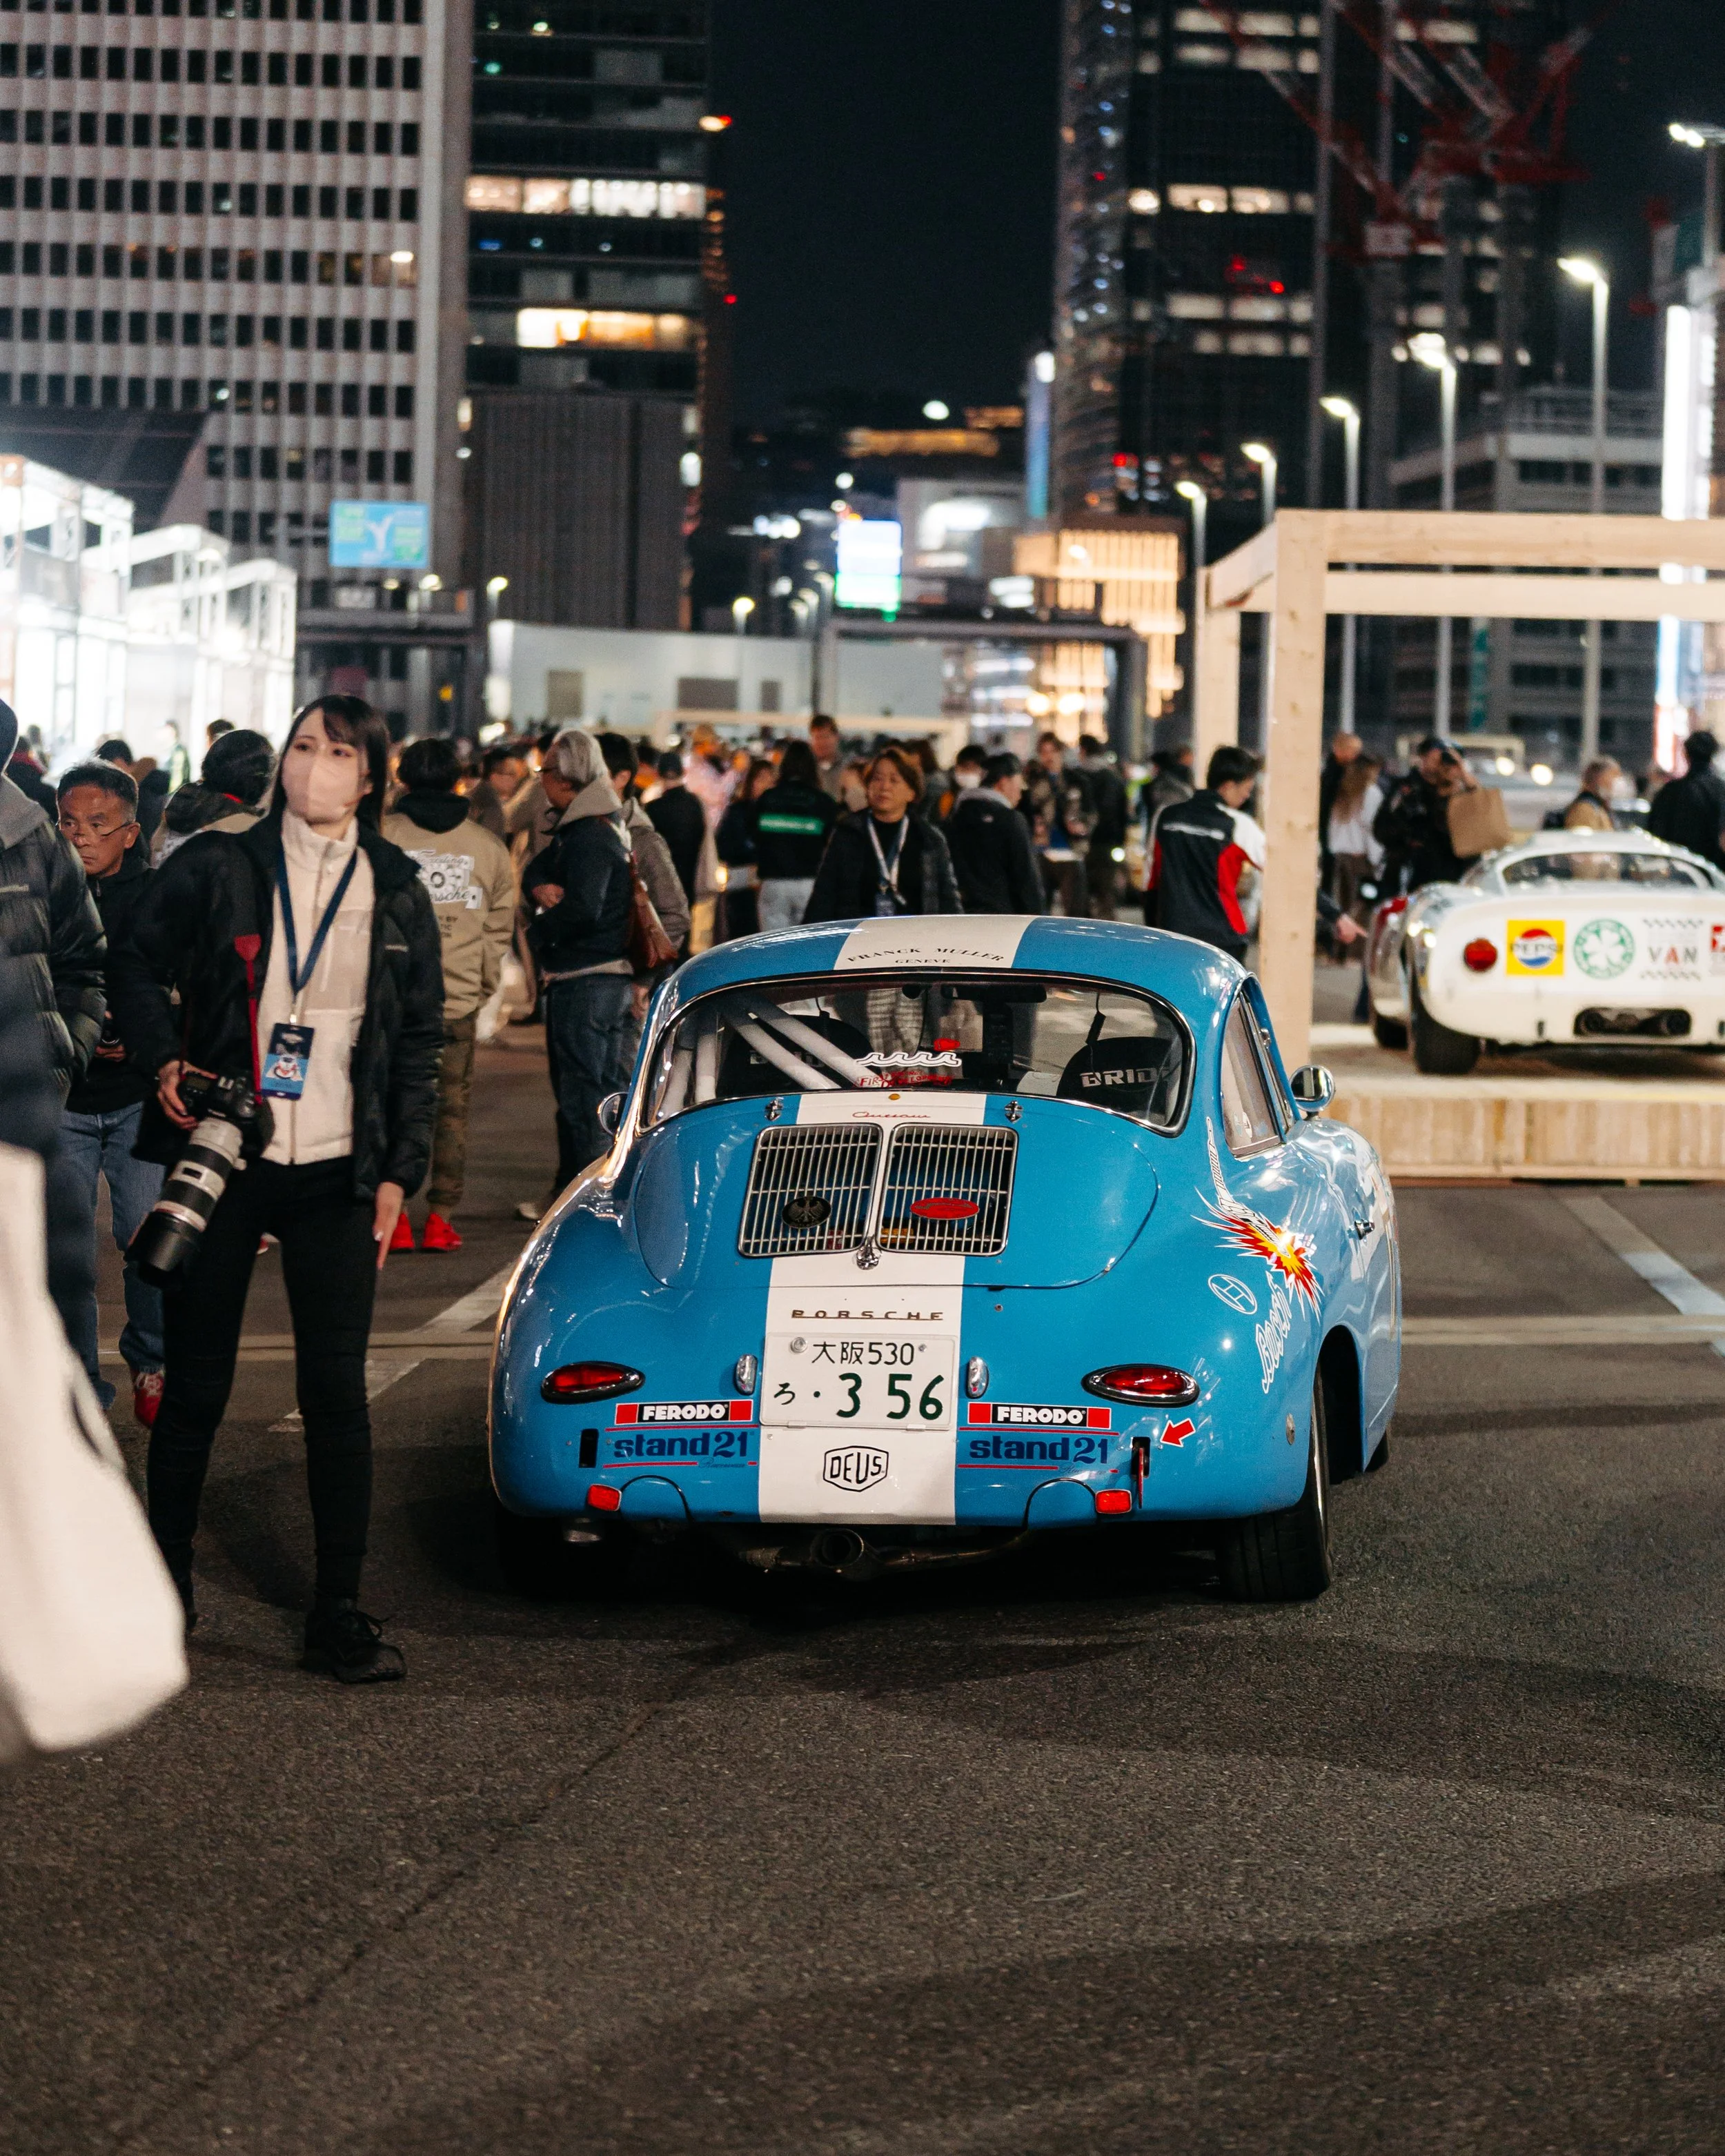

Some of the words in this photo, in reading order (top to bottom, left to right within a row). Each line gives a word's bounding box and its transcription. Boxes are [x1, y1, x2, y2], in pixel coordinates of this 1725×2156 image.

[847, 948, 921, 962] FRANCK
[933, 947, 1005, 962] MULLER
[1510, 943, 1564, 953] PEPSI
[791, 1309, 945, 1321] PORSCHE
[642, 1403, 727, 1421] FERODO
[997, 1406, 1084, 1424] FERODO
[829, 1452, 883, 1484] DEUS
